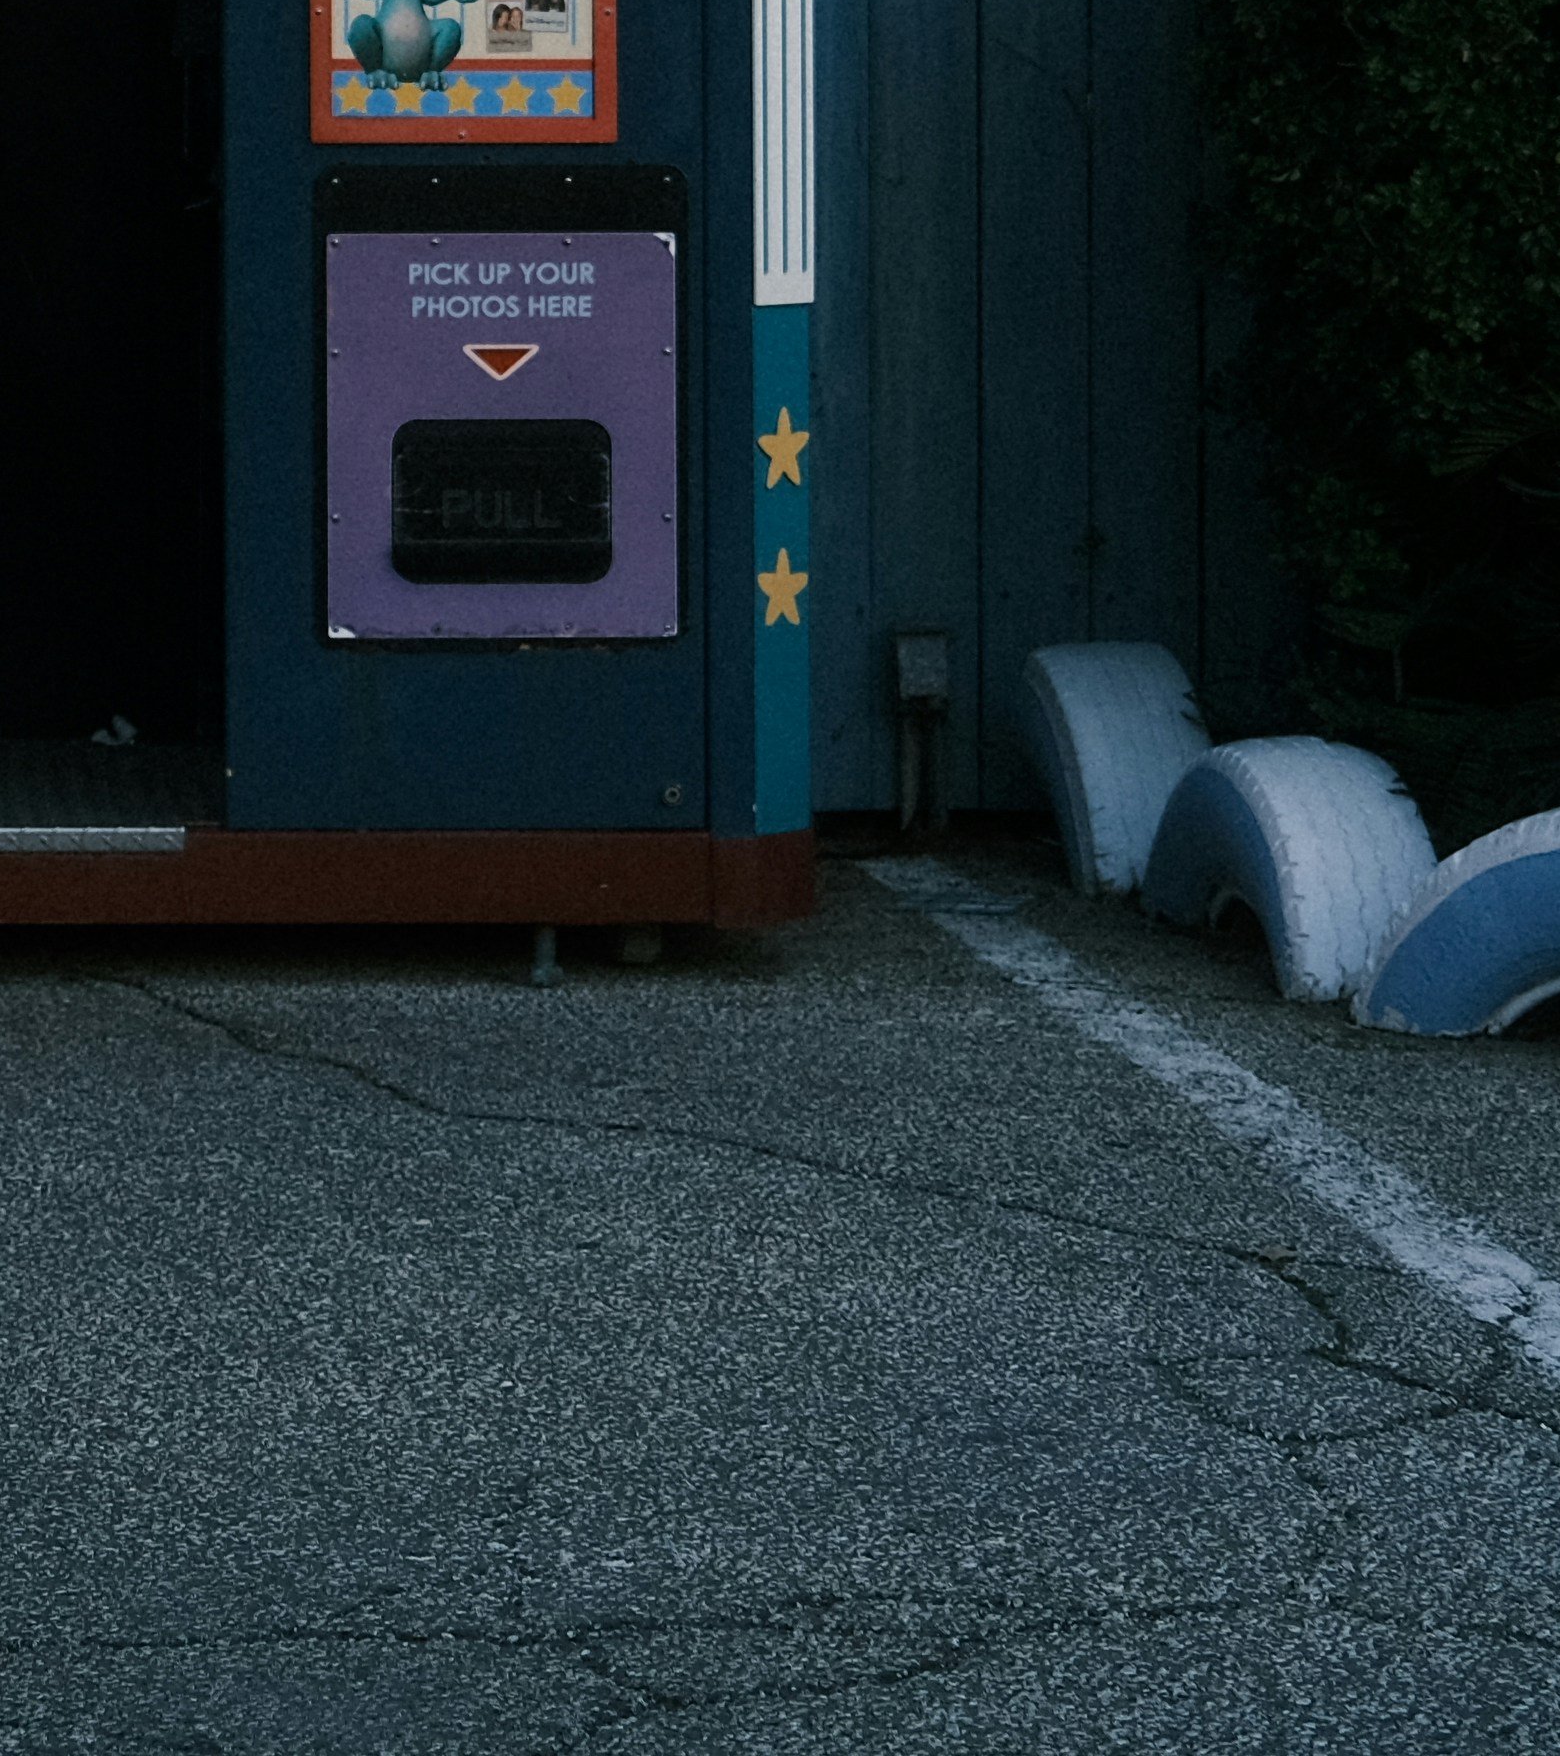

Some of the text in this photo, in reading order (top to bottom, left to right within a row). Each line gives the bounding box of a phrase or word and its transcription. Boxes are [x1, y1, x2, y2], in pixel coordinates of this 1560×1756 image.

[408, 262, 594, 285] PICK UP YOUR
[411, 295, 592, 318] PHOTOS HERE
[441, 488, 564, 529] PULL
